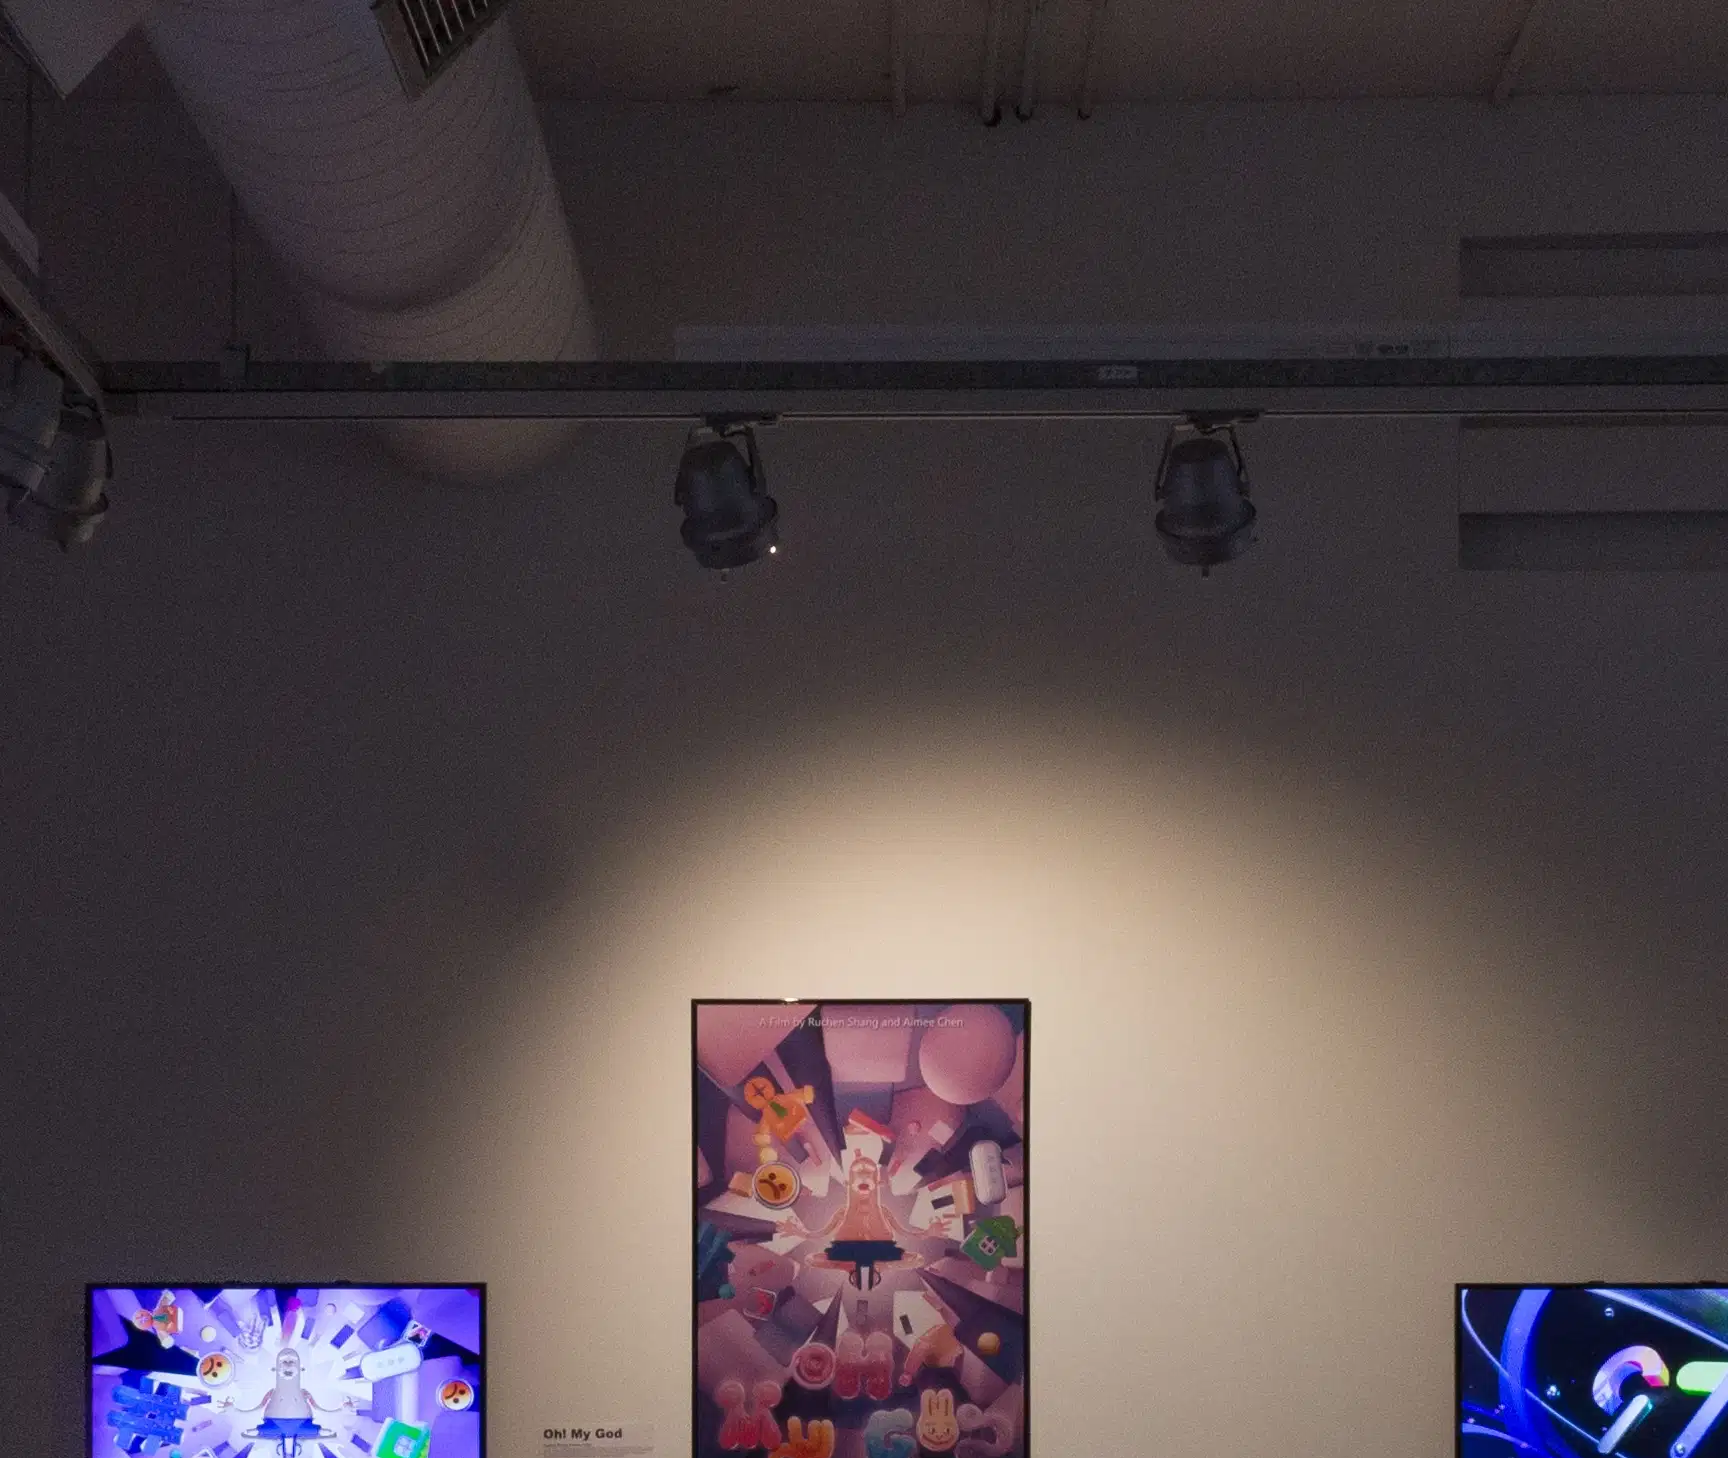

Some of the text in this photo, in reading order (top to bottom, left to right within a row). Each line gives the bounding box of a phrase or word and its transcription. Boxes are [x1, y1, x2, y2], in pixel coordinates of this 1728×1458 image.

[768, 1017, 790, 1027] Film
[793, 1017, 806, 1030] by
[847, 1017, 879, 1030] Shang
[882, 1017, 901, 1028] and
[903, 1018, 935, 1028] Aimee
[937, 1018, 963, 1028] Chen
[543, 1428, 623, 1441] Oh! My God
